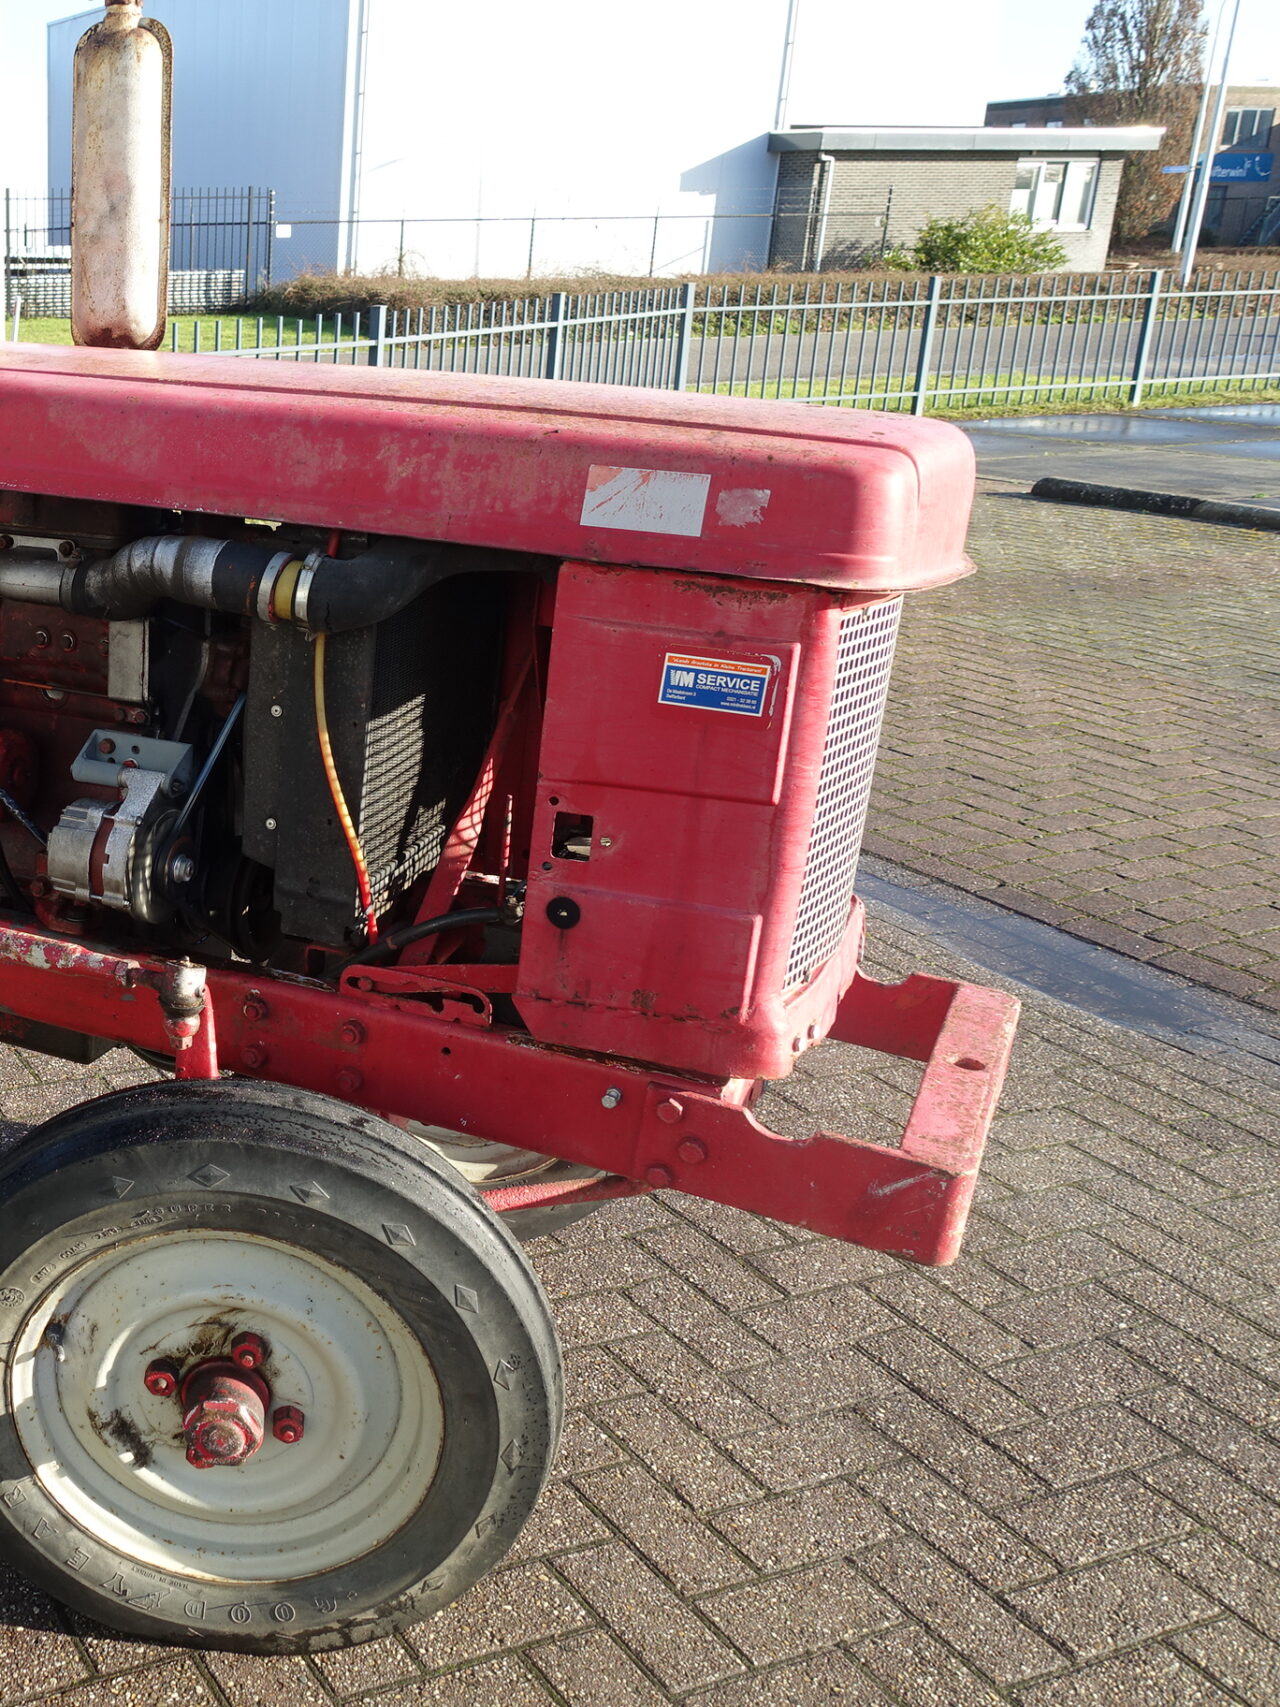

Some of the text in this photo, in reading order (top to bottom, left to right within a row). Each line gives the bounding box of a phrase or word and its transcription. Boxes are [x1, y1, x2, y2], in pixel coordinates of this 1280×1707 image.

[695, 684, 721, 692] COMPACT
[696, 673, 761, 691] SERVICE
[2, 1487, 338, 1625] GOODYEAR
